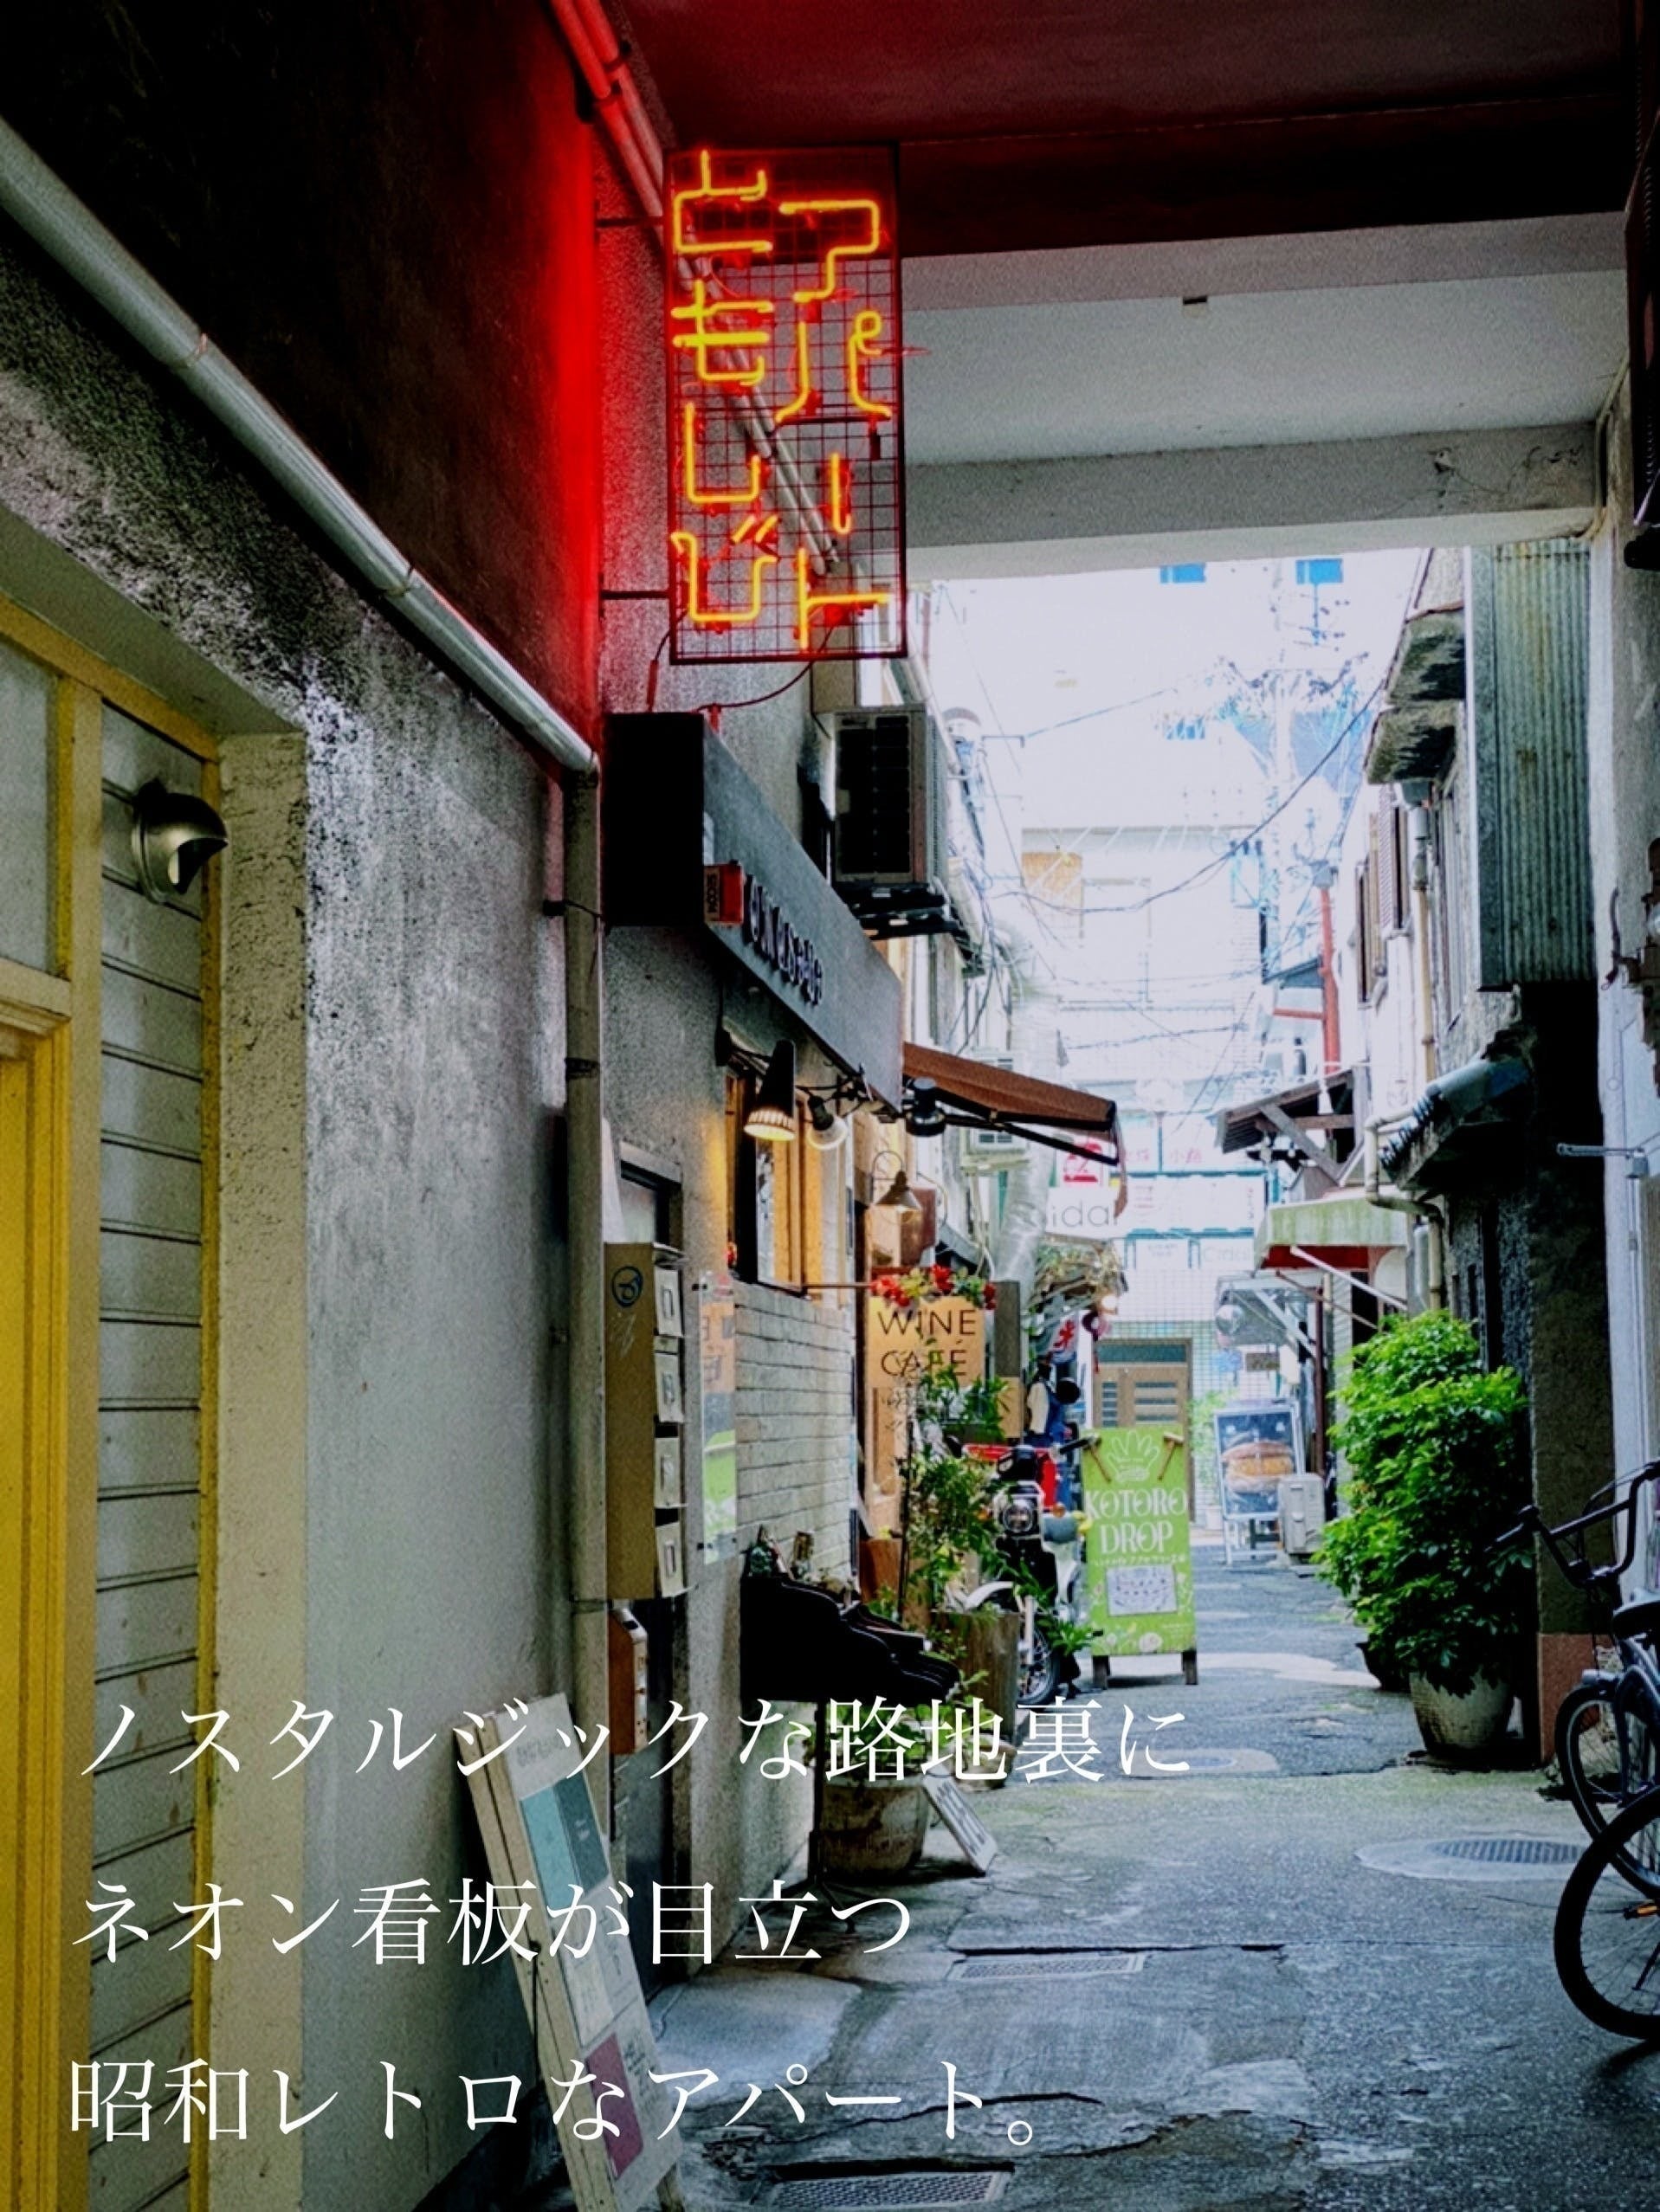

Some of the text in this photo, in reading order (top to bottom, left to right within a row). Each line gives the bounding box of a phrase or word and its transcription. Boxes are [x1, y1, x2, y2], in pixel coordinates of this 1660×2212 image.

[778, 197, 894, 653] アパート
[876, 1308, 977, 1337] WINE
[1084, 1487, 1187, 1519] KOTORO
[1100, 1520, 1173, 1554] DROP
